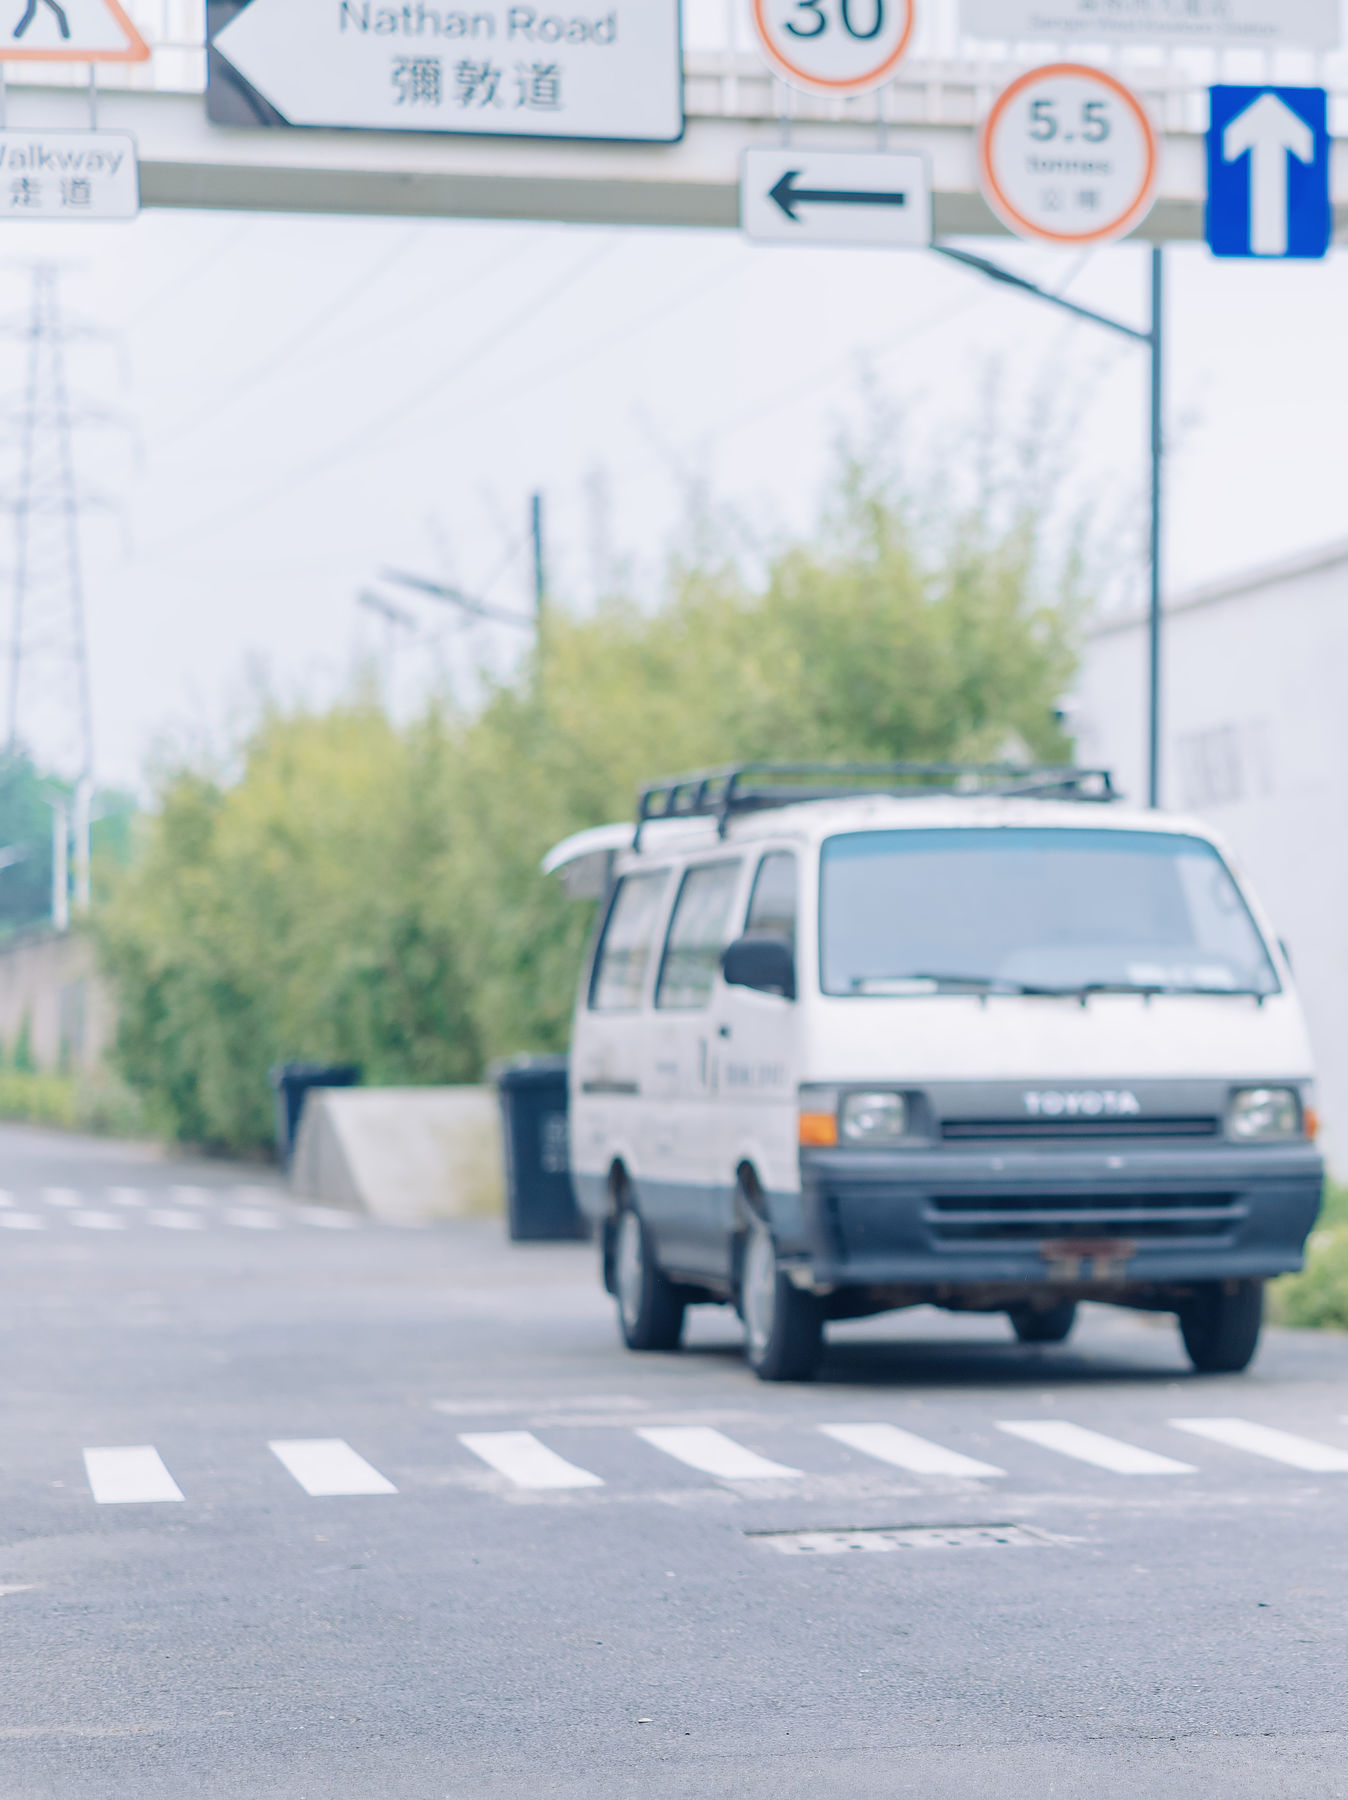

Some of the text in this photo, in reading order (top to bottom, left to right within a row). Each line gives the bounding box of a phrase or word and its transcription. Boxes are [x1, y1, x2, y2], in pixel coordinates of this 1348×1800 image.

[338, 0, 618, 46] Nathan Road
[391, 57, 564, 111] 彌敦道
[1028, 99, 1111, 143] 5.5
[1024, 1090, 1141, 1116] TOYOTA
